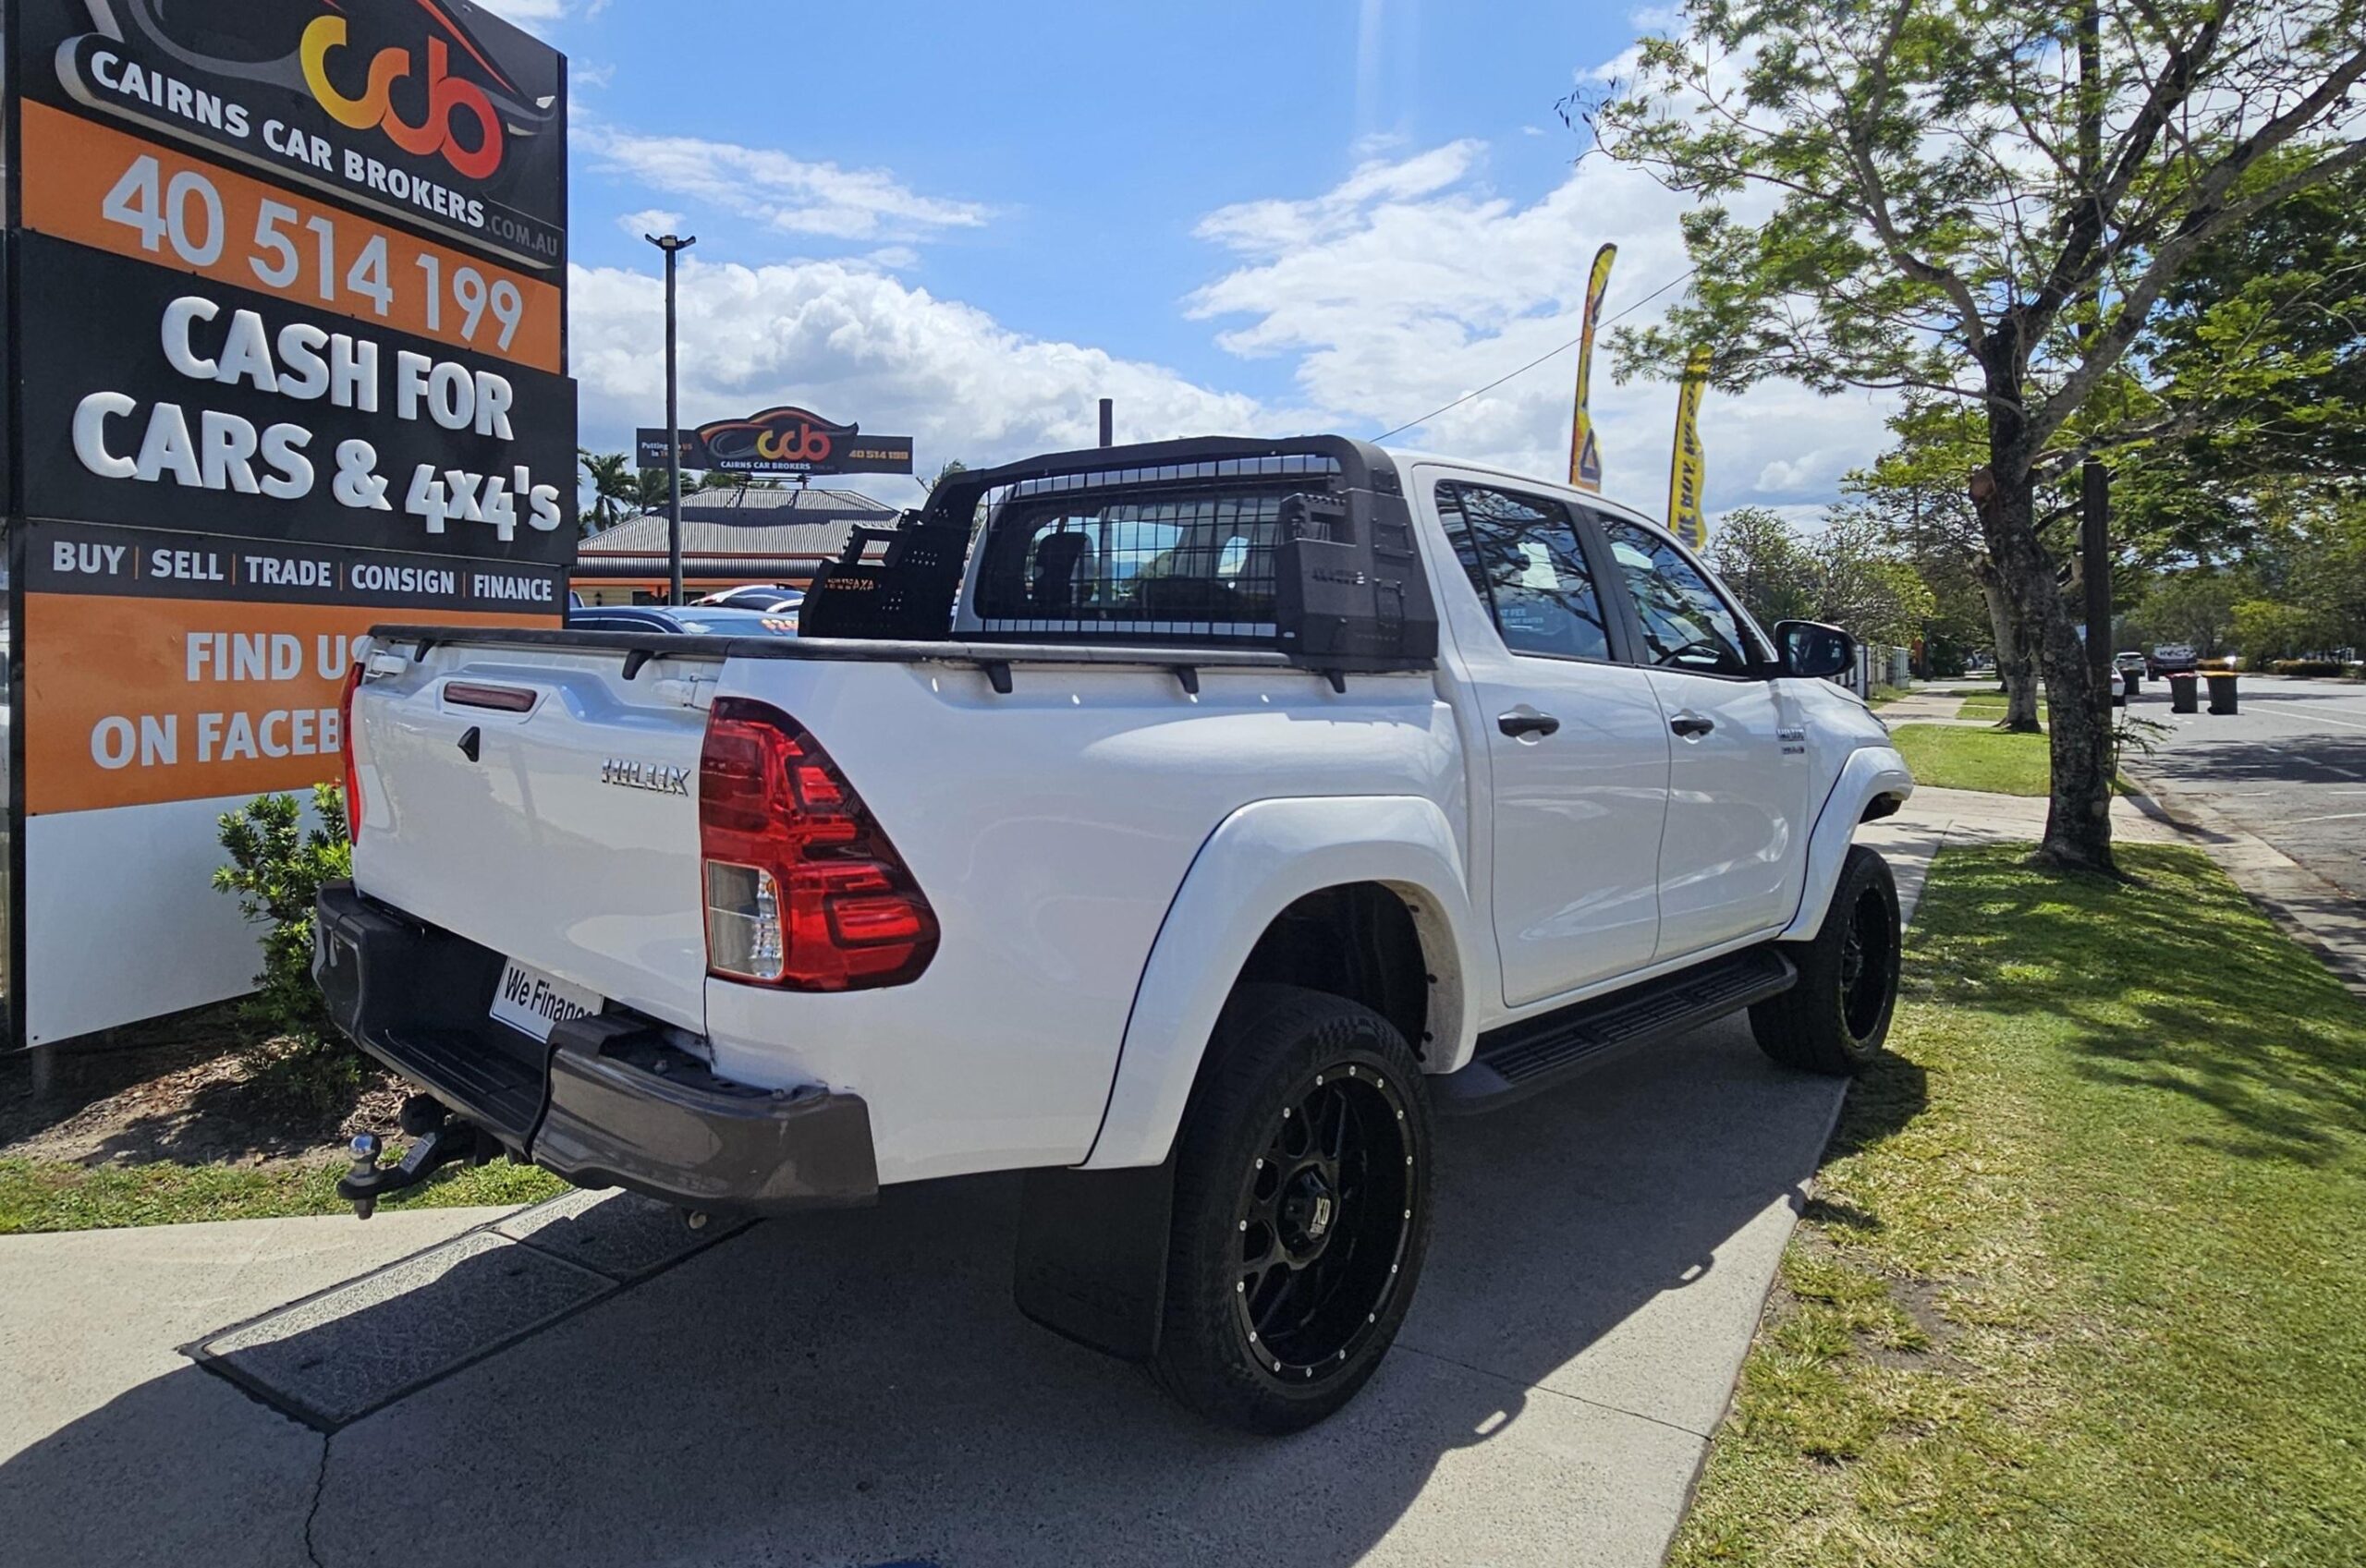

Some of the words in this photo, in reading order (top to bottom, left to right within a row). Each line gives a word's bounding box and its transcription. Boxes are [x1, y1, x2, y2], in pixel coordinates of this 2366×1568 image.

[91, 51, 250, 139] CAIRNS
[263, 119, 333, 172] CAR
[344, 149, 485, 229] BROKERS
[102, 154, 225, 267] 40
[248, 198, 394, 317] 514
[415, 252, 524, 352] 199
[161, 296, 378, 412] CASH
[397, 350, 514, 441] FOR
[72, 391, 314, 500] CARS
[333, 439, 393, 511] &
[721, 460, 752, 469] CAIRNS
[753, 461, 770, 469] CAR
[772, 462, 811, 470] BROKERS
[848, 449, 865, 458] 40
[866, 450, 886, 459] 514
[54, 541, 126, 575] BUY
[151, 549, 224, 581] SELL
[245, 555, 332, 588] TRADE
[351, 564, 455, 594] CONSIGN
[473, 574, 553, 602] FINANCE
[187, 632, 302, 682] FIND
[91, 713, 178, 770] ON
[602, 758, 690, 797] HILUX
[505, 966, 531, 1006] We
[1312, 1197, 1331, 1225] XD
